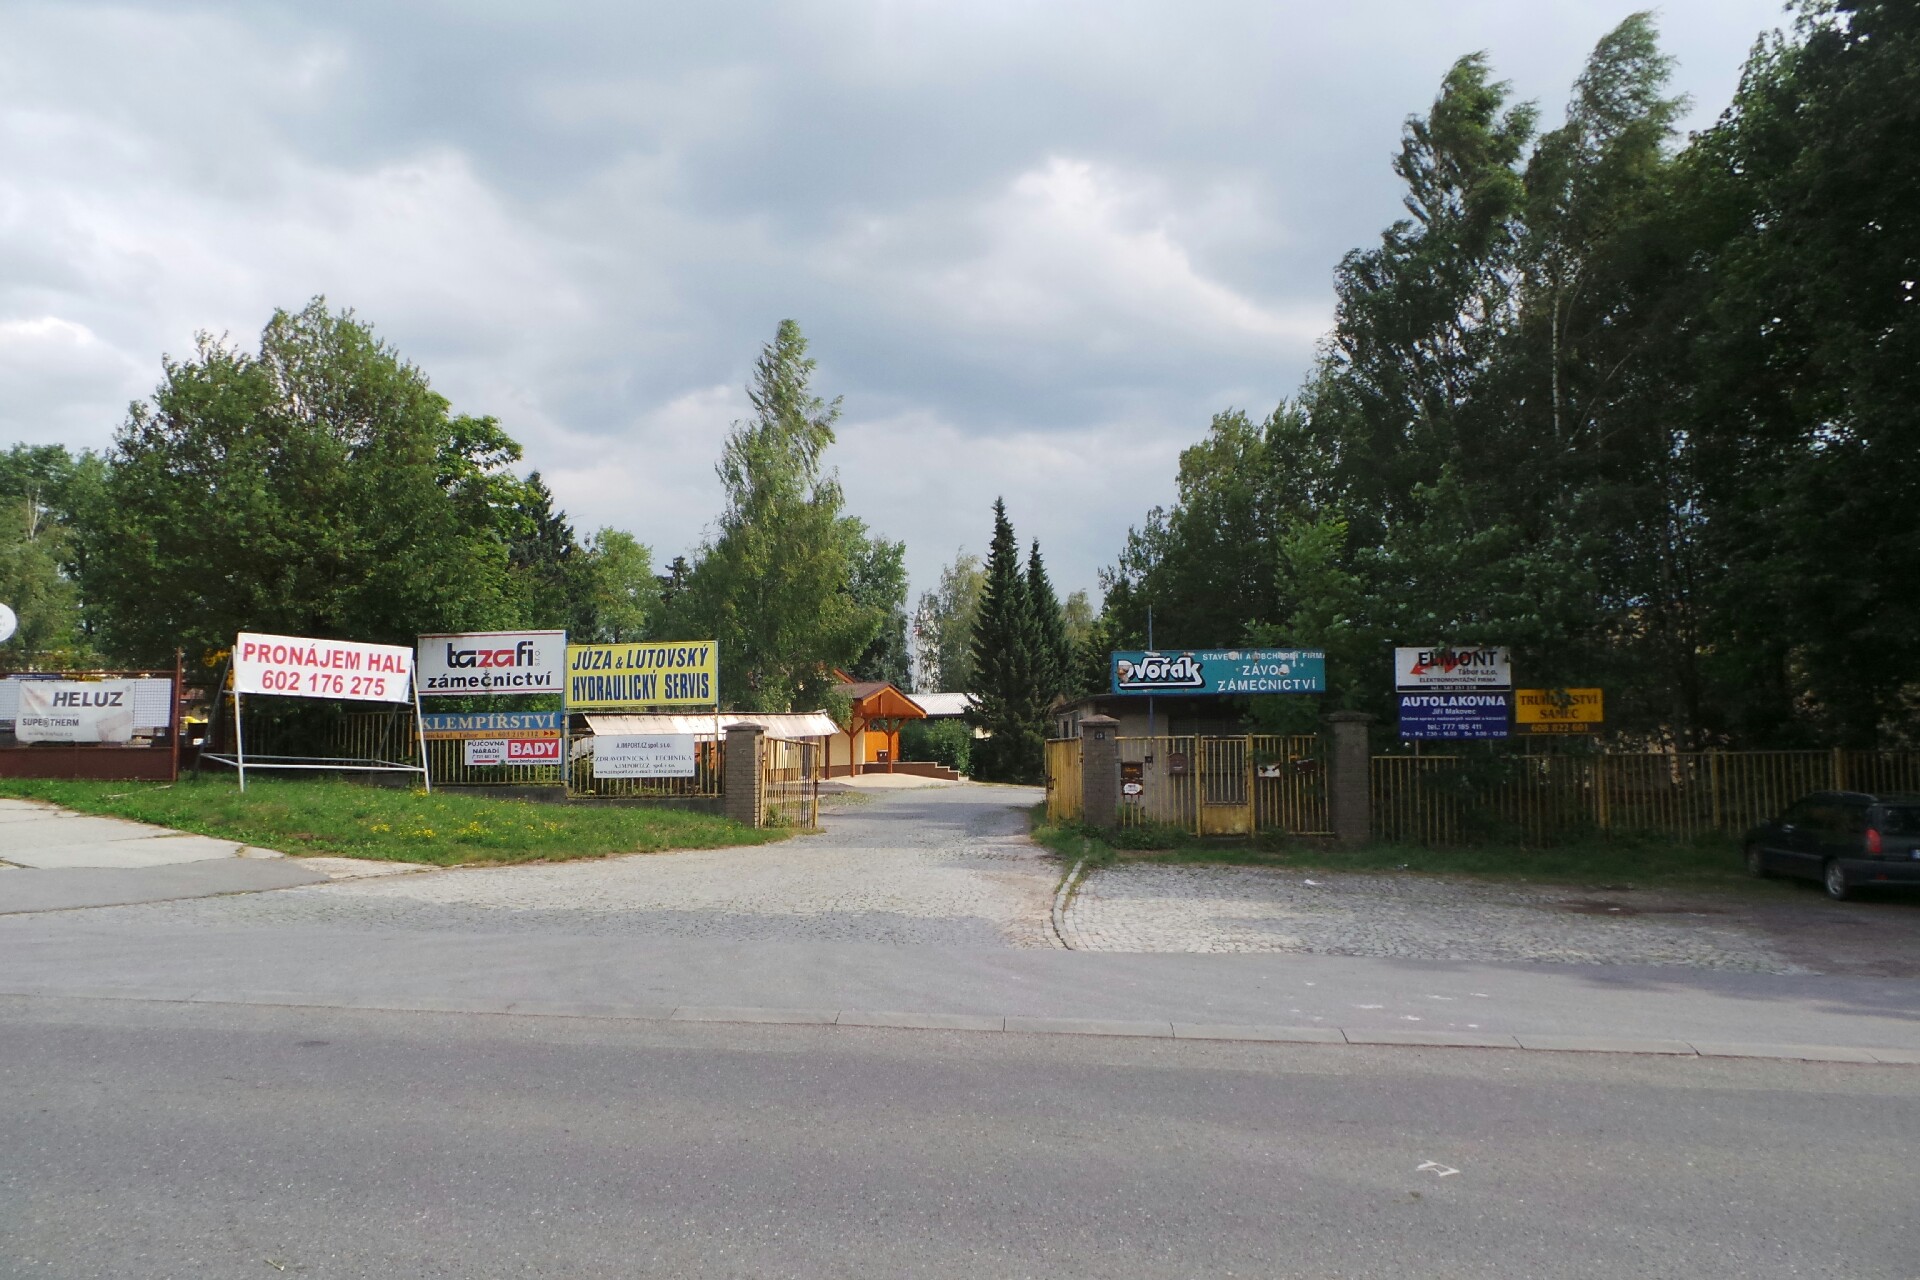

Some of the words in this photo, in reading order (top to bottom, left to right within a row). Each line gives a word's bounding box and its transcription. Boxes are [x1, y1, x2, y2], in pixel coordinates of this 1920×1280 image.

[242, 642, 361, 670] PRONÁJEM
[368, 652, 406, 674] HAL
[447, 641, 534, 668] tazafi
[572, 646, 612, 670] JŮZA
[616, 656, 623, 668] &
[626, 644, 708, 668] LUTOVSKÝ
[1243, 664, 1290, 676] ZÁVO
[262, 670, 300, 690] 602
[308, 672, 344, 694] 176
[350, 676, 386, 696] 275
[428, 671, 552, 688] zámečnictví
[572, 670, 658, 701] HYDRAULICKÝ
[664, 672, 709, 699] SERVIS
[1218, 676, 1316, 692] ZÁMEČNICTVÍ
[52, 692, 124, 708] HELUZ
[1402, 696, 1506, 706] AUTOLAKOVNA
[421, 712, 556, 730] KLEMPÍŘSTVÍ
[510, 742, 556, 756] BADY
